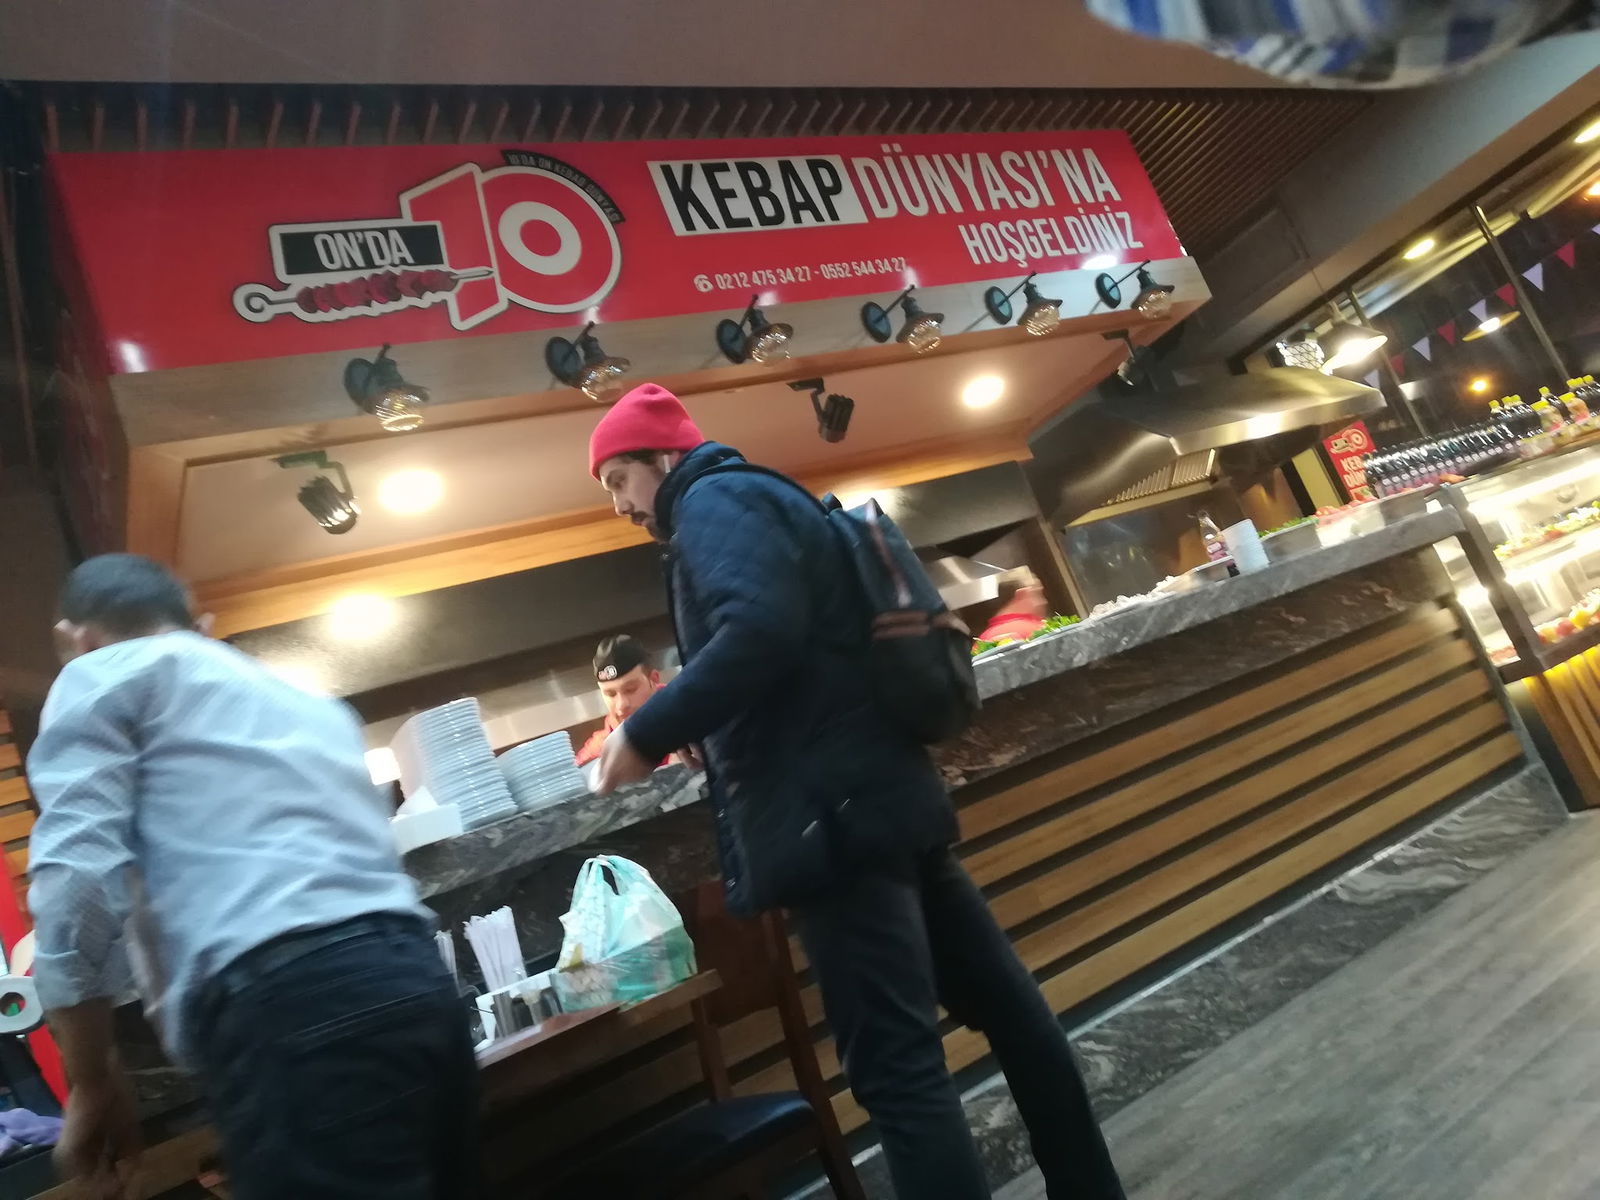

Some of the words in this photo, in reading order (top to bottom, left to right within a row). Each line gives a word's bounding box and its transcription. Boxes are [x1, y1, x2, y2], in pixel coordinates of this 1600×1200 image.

[661, 157, 843, 232] KEBAP
[851, 143, 1122, 219] DÜNYASI'NA
[313, 229, 415, 270] ON'DA
[400, 163, 622, 331] 10
[958, 207, 1143, 268] HOŞGELDİNİZ
[714, 271, 751, 290] 0212
[751, 269, 777, 286] 475
[776, 267, 795, 284] 34
[794, 265, 812, 282] 27
[821, 261, 852, 280] 0552
[851, 259, 876, 276] 544
[874, 258, 893, 275] 34
[891, 256, 908, 273] 27
